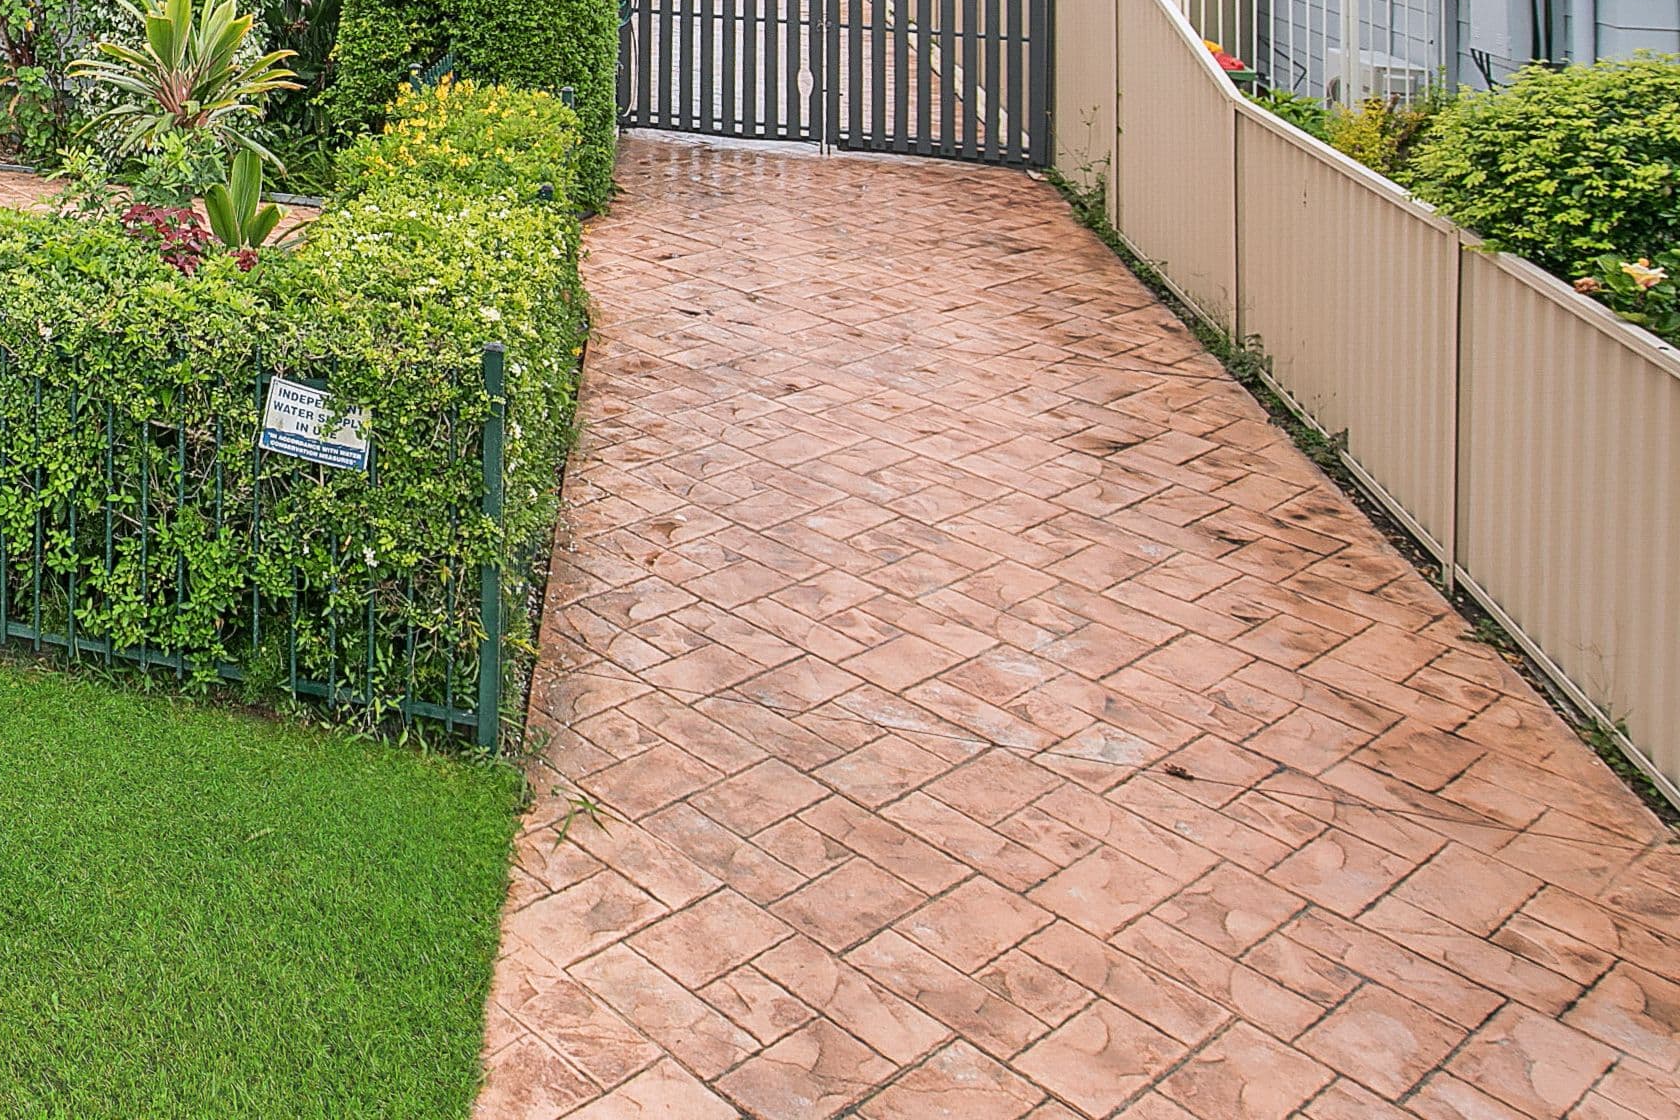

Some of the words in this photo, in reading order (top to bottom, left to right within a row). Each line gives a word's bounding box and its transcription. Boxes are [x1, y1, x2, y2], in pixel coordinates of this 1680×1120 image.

[273, 400, 314, 420] WATER
[278, 387, 363, 417] INDEPENT
[295, 421, 309, 433] IN
[313, 425, 338, 439] UE
